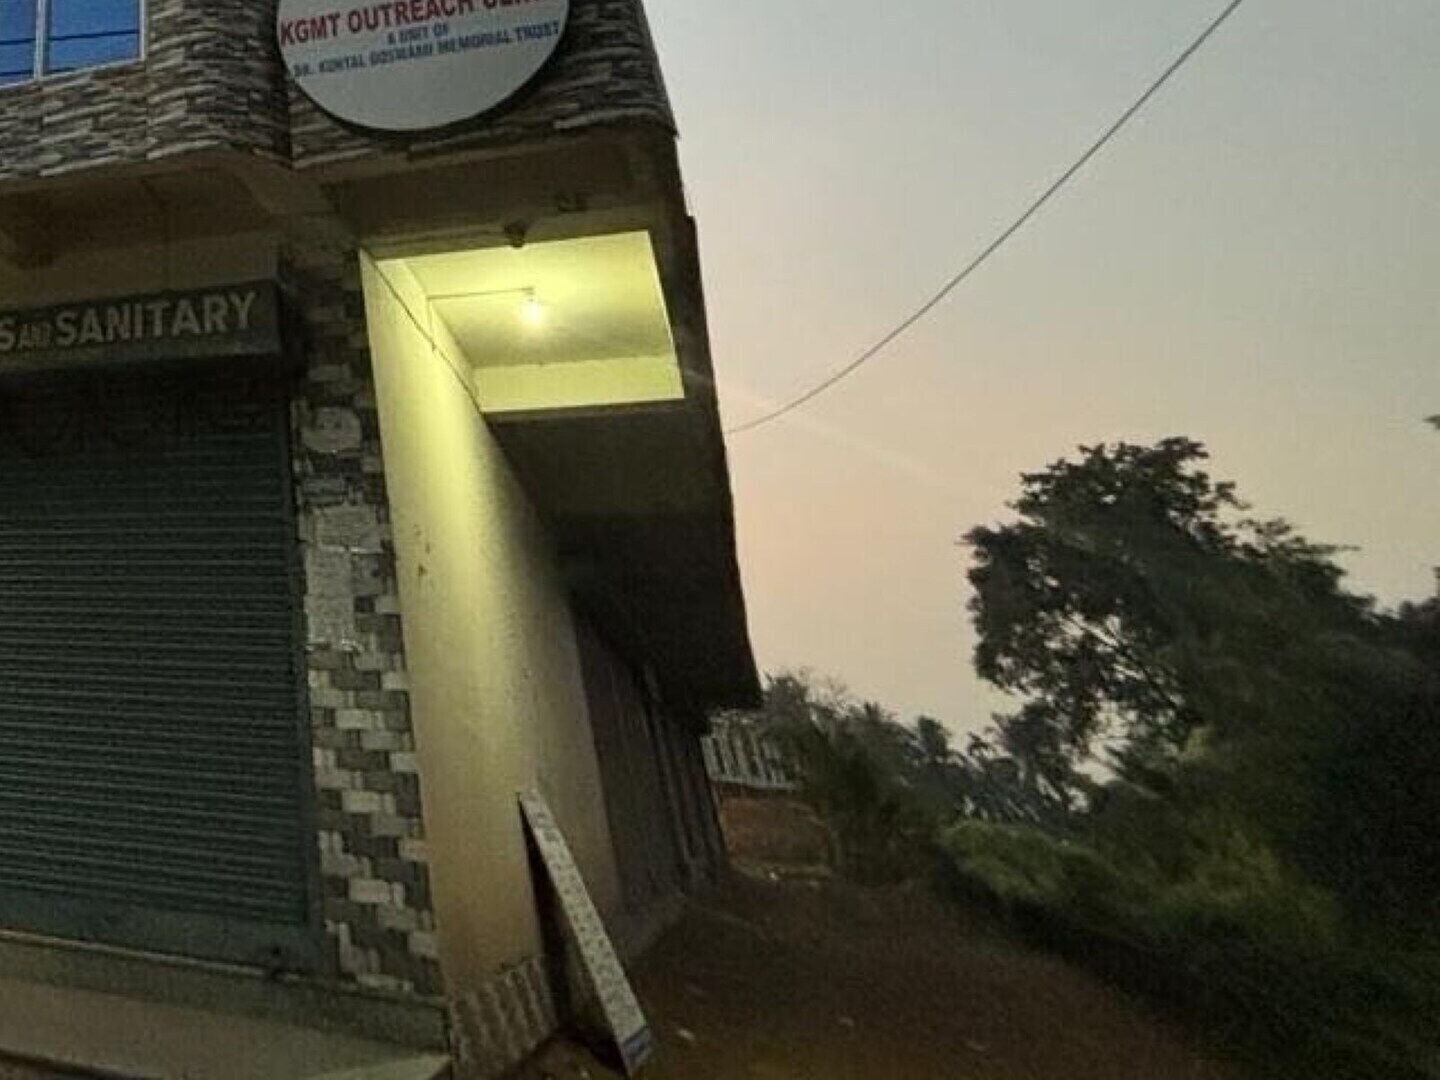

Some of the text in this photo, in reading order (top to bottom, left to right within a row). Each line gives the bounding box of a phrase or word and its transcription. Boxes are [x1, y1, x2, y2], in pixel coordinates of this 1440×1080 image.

[281, 13, 341, 46] KGMT
[437, 31, 512, 55] MEMORIAL
[515, 21, 560, 40] TRUST
[55, 290, 258, 346] SANITARY
